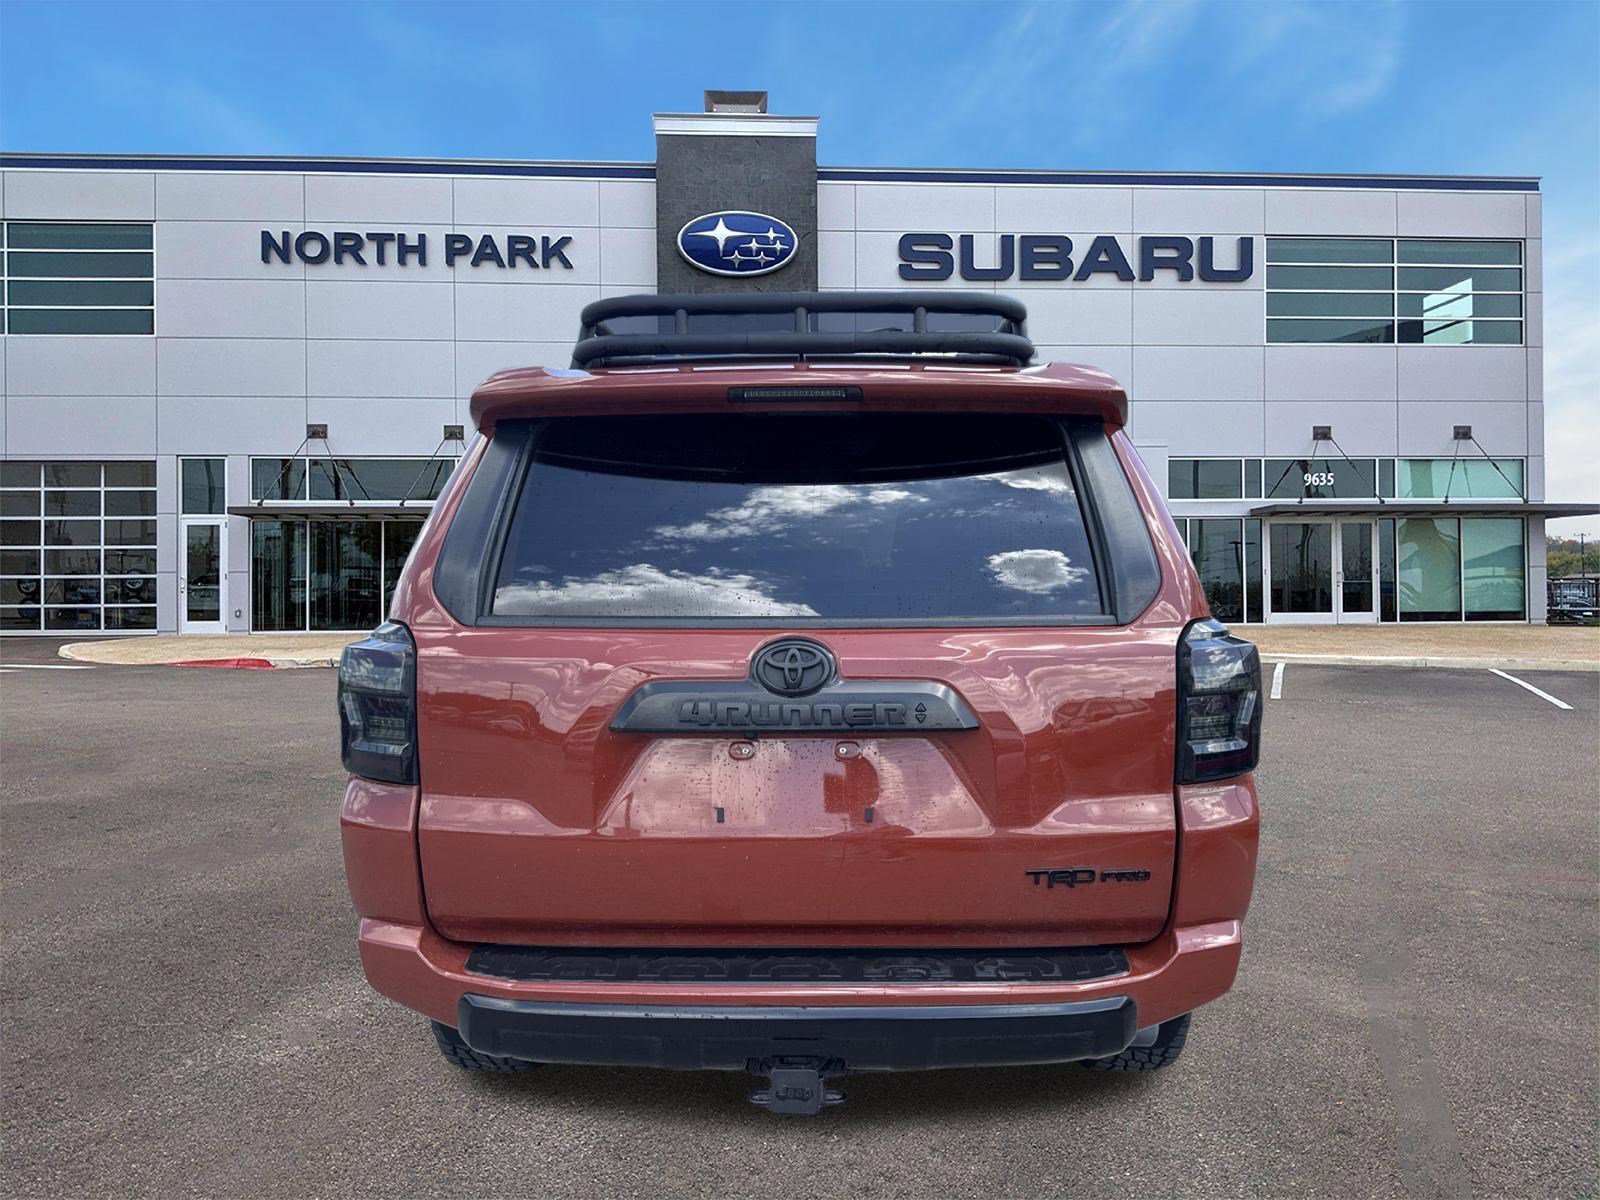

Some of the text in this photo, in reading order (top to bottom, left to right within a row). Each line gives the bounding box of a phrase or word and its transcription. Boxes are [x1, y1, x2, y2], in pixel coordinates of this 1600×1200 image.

[260, 230, 574, 269] NORTH PARK
[898, 232, 1254, 282] SUBARU
[1303, 472, 1335, 486] 9635
[1025, 868, 1152, 889] TRD PRO
